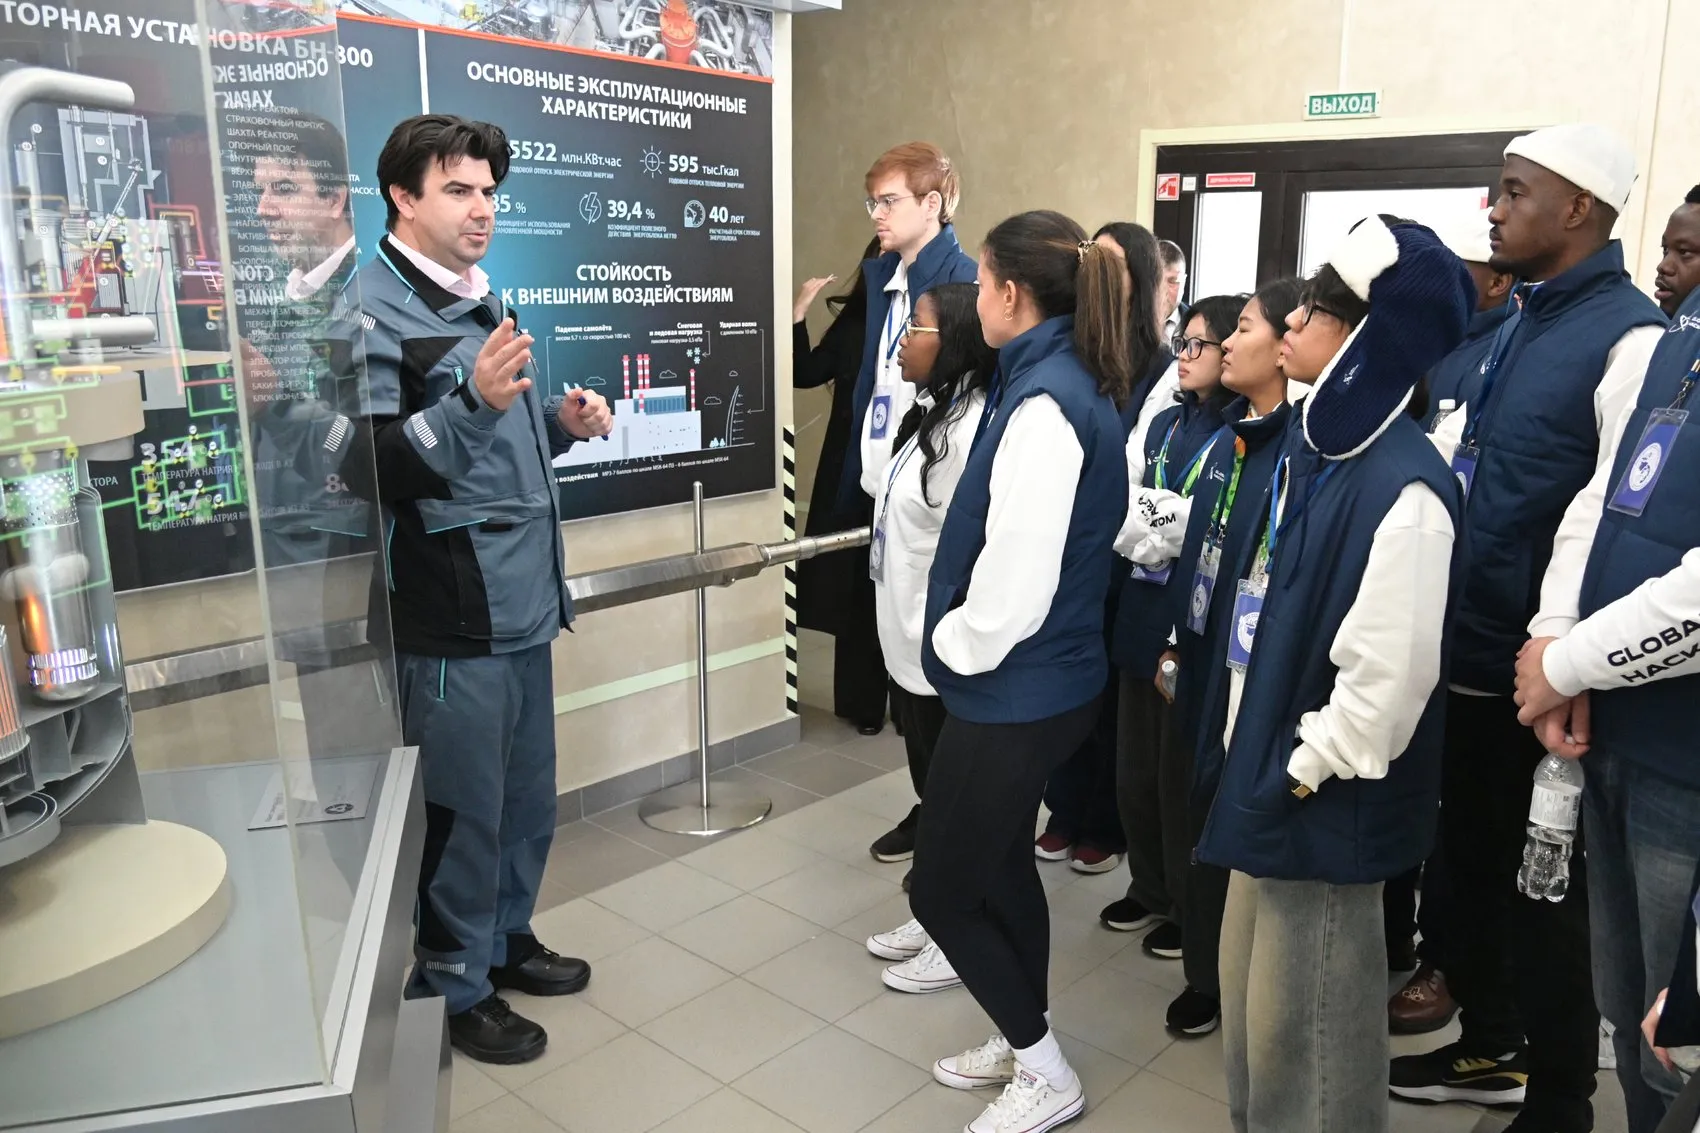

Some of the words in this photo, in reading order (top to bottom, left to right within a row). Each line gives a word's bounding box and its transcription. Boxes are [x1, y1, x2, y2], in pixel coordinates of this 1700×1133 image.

[295, 38, 373, 68] БН-800
[466, 62, 574, 93] ОСНОВНЫЕ
[578, 76, 747, 114] ЭКСПЛУАТАЦИОННЫЕ
[542, 95, 692, 130] ХАРАКТЕРИСТИКИ
[1311, 95, 1373, 114] ВЫХОД
[227, 128, 256, 138] ШАХТА
[258, 130, 299, 141] РЕАКТОРА
[228, 141, 271, 152] ОПОРНЫЙ
[509, 140, 557, 162] 5522
[669, 154, 699, 173] 595
[702, 165, 739, 177] тыс.Гкал
[516, 202, 527, 213] %
[607, 199, 642, 221] 39,4
[645, 208, 655, 219] %
[709, 206, 729, 223] 40
[730, 215, 745, 223] лет
[576, 262, 672, 282] СТОЙКОСТЬ
[502, 289, 514, 306] К
[518, 287, 610, 306] ВНЕШНИМ
[612, 286, 734, 307] ВОЗДЕЙСТВИЯМ
[1607, 619, 1700, 667] GLOBA
